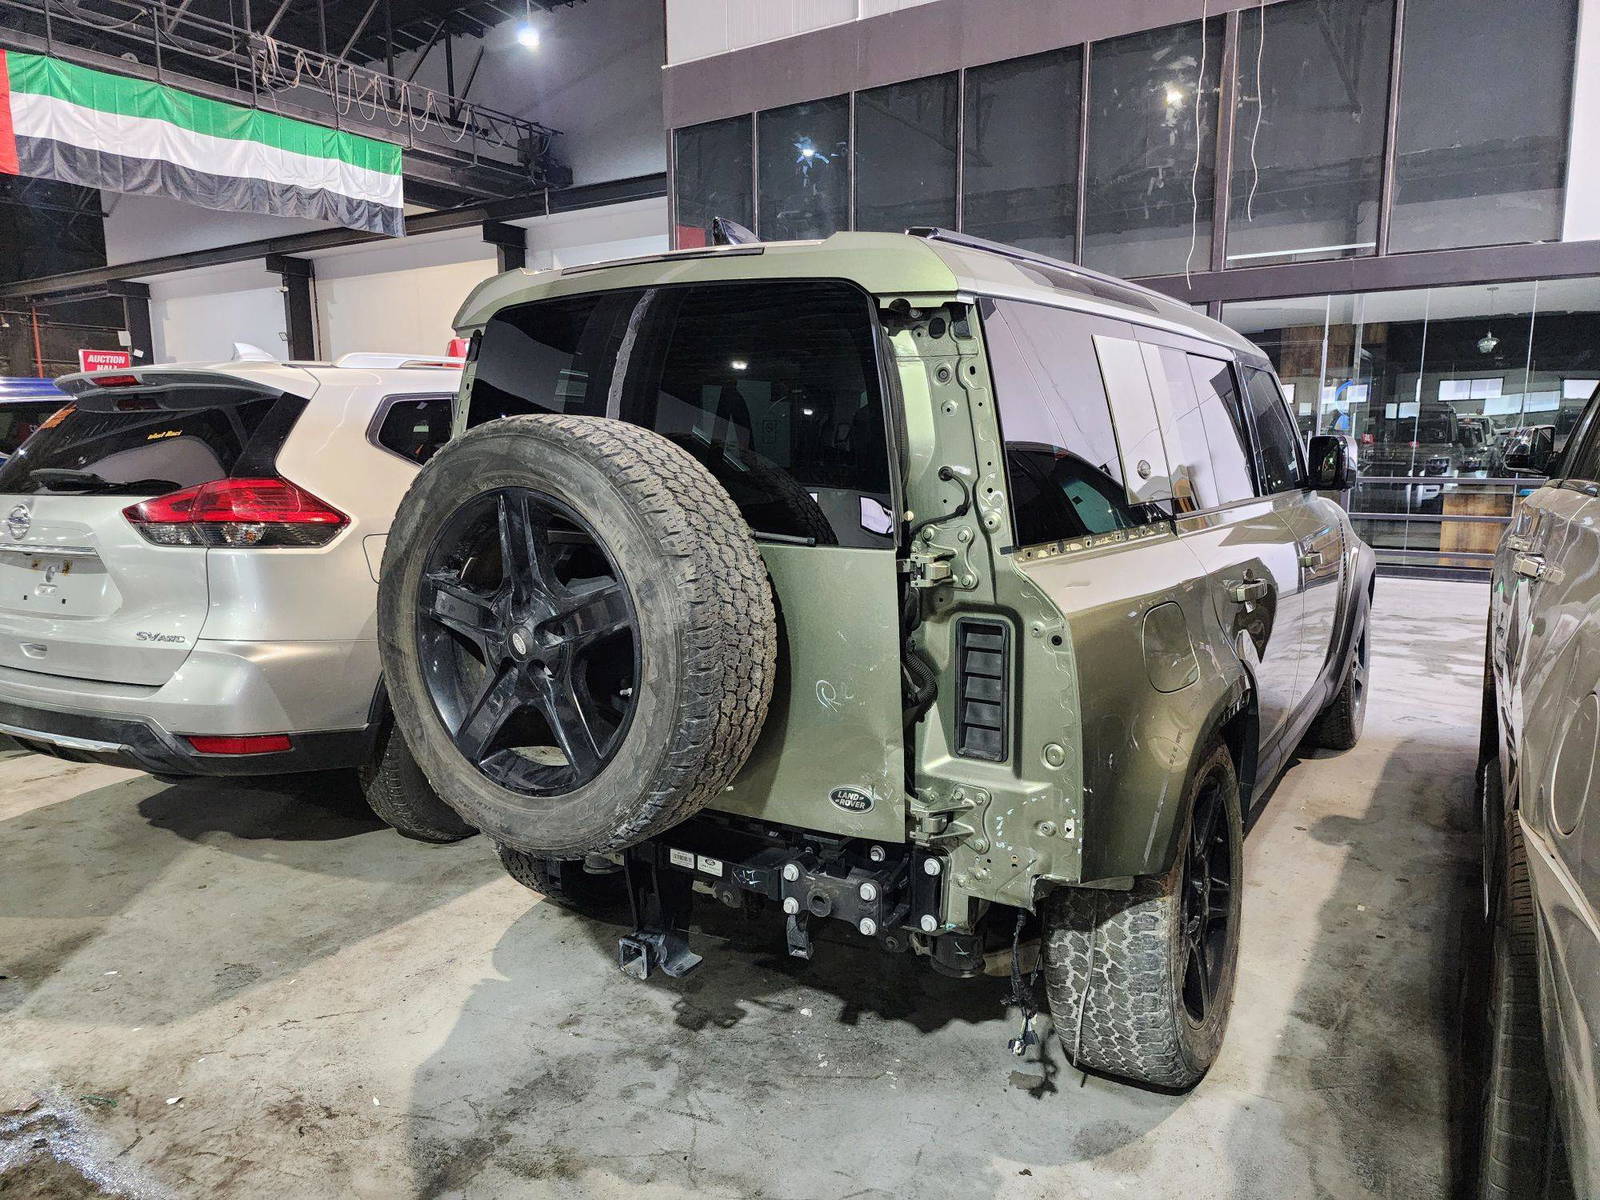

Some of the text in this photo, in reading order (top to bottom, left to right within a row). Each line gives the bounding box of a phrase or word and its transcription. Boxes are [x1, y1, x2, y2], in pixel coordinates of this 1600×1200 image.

[88, 354, 126, 364] AUCTION
[837, 791, 860, 801] LAND
[839, 798, 866, 810] ROVER
